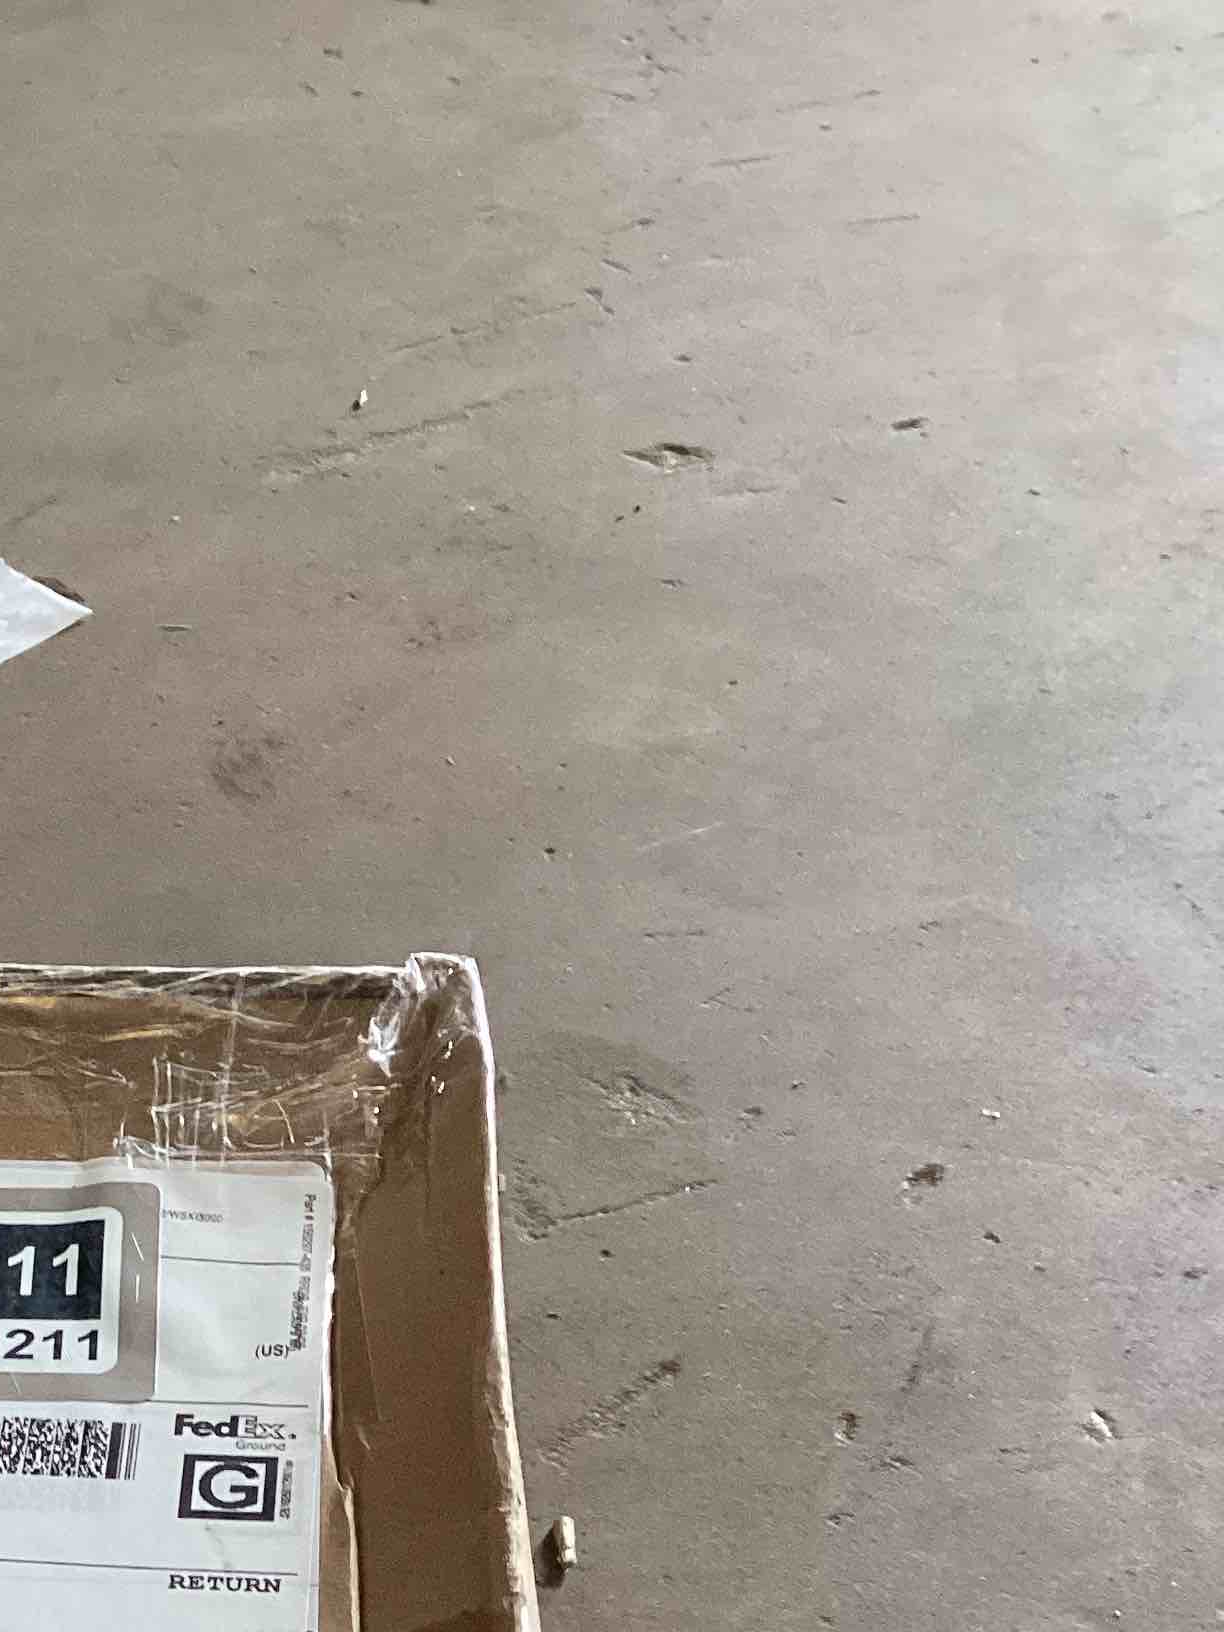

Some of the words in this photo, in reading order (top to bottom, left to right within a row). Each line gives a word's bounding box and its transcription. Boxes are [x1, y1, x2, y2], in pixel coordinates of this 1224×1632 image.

[255, 1343, 290, 1360] (US)
[174, 1413, 286, 1441] FedEx
[235, 1440, 286, 1451] Ground
[198, 1463, 260, 1510] G
[167, 1574, 282, 1593] RETURN
